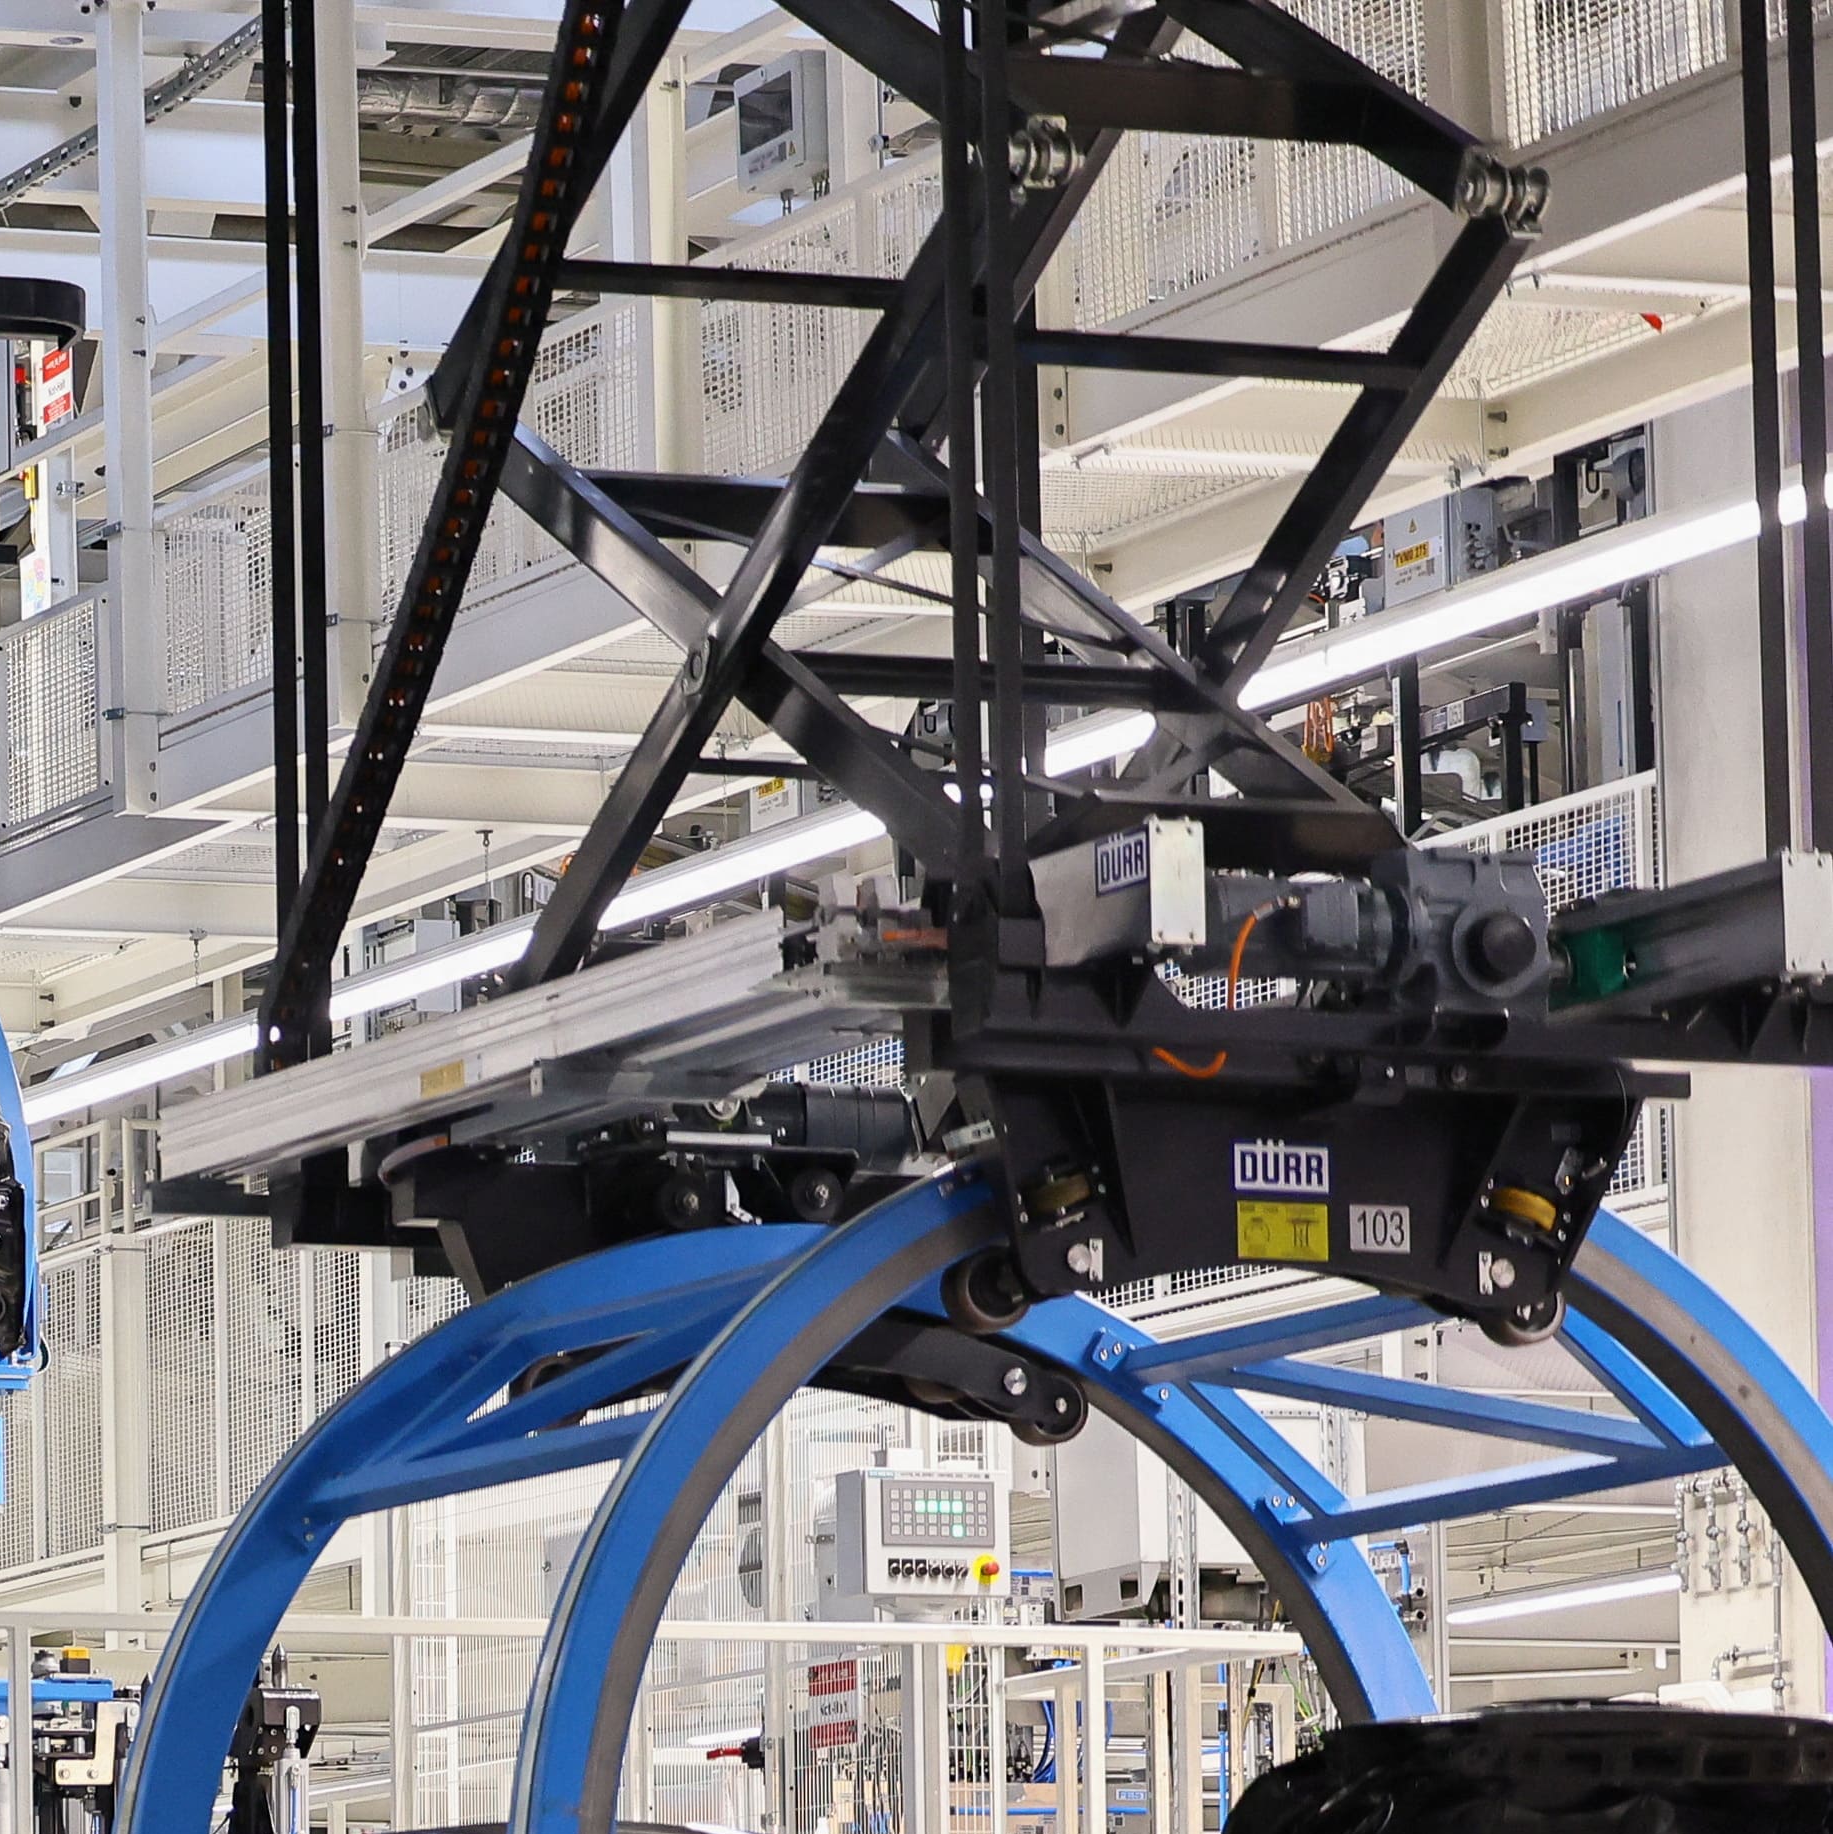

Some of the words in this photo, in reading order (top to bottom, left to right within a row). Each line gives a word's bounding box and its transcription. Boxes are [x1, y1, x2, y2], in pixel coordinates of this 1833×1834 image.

[1100, 832, 1144, 885] DÜRR
[1240, 1138, 1324, 1187] DÜRR
[1357, 1208, 1405, 1248] 103
[1118, 1790, 1147, 1800] FEST
